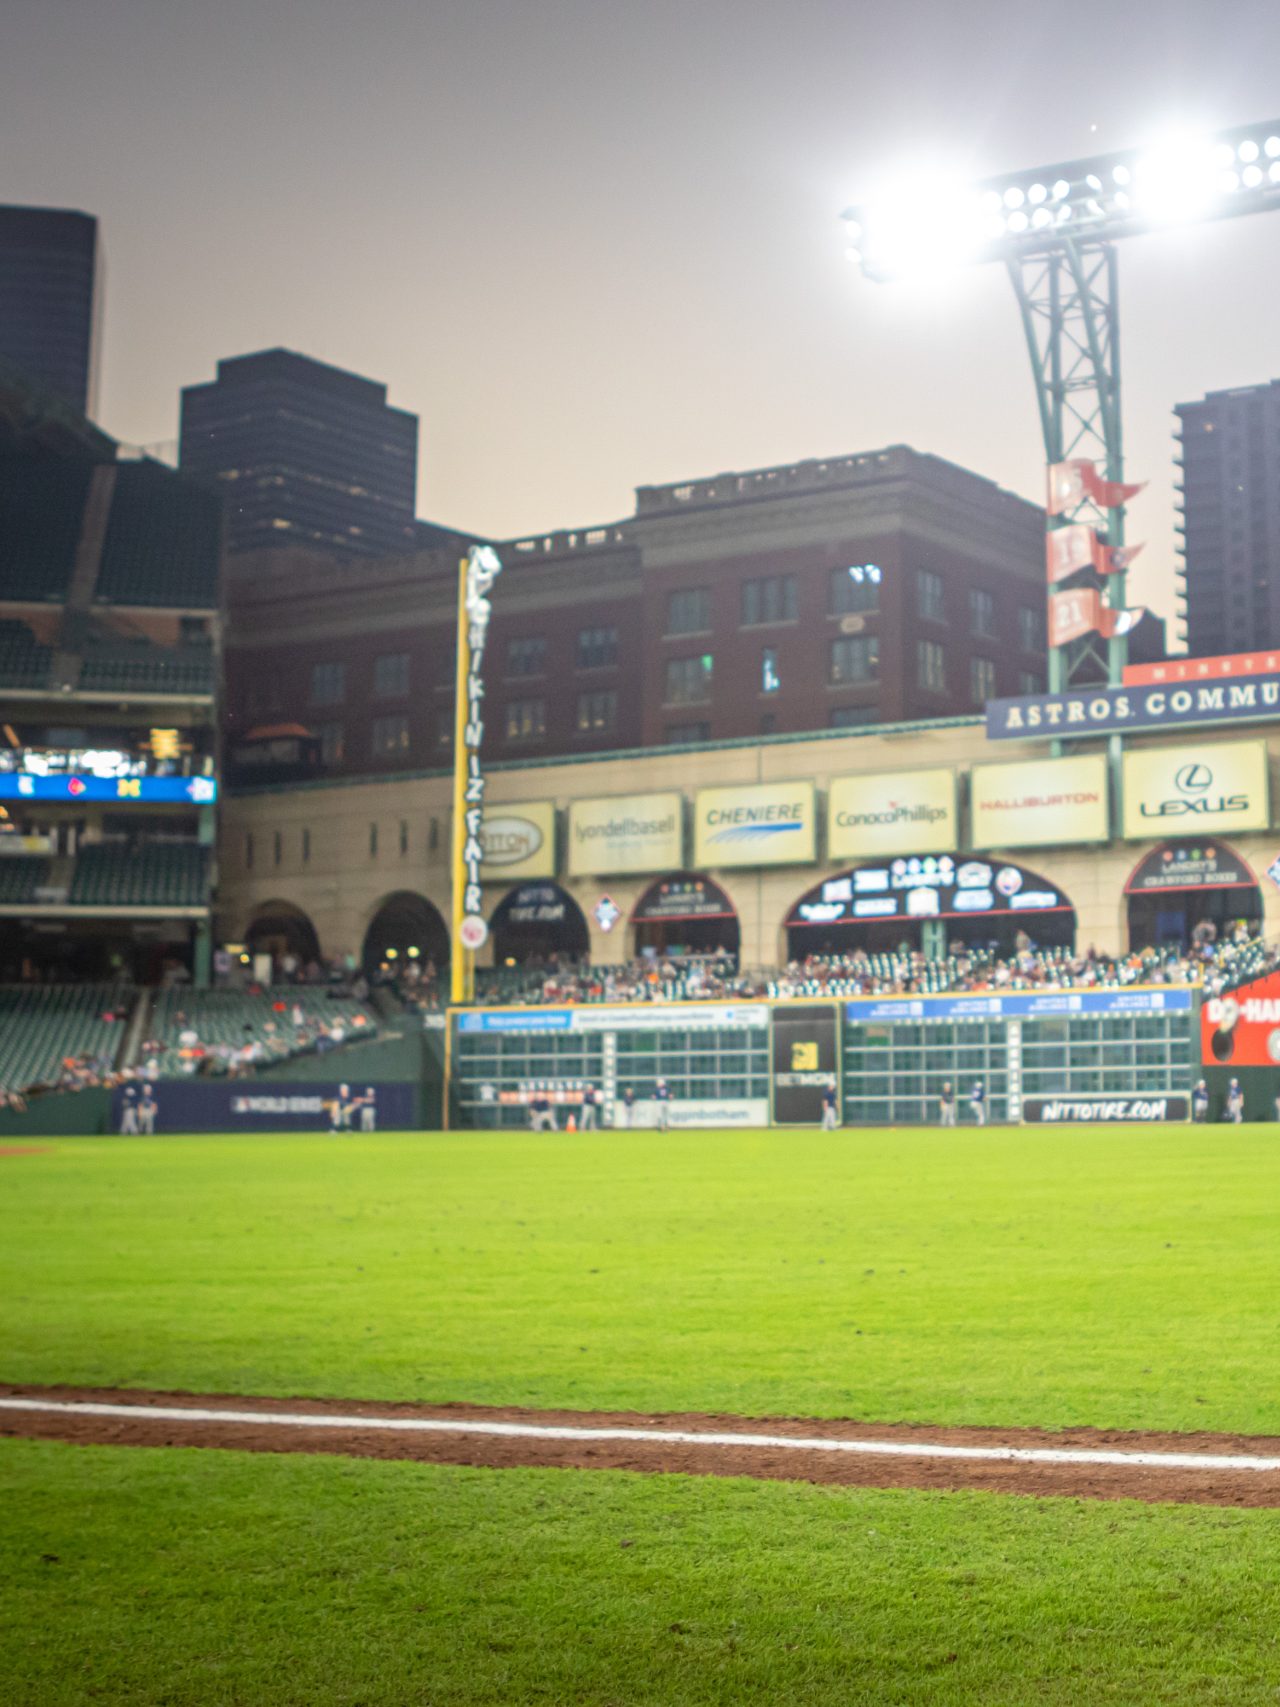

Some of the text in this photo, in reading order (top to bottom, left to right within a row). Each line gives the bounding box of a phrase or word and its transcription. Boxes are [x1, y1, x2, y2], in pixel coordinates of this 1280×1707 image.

[979, 792, 1099, 811] HALLIBURTON
[1140, 795, 1250, 818] LEXUS
[706, 803, 804, 826] CHENIERE
[836, 803, 948, 828] ConocoPhillips
[1042, 1099, 1167, 1121] NITTOTIRE.COM
